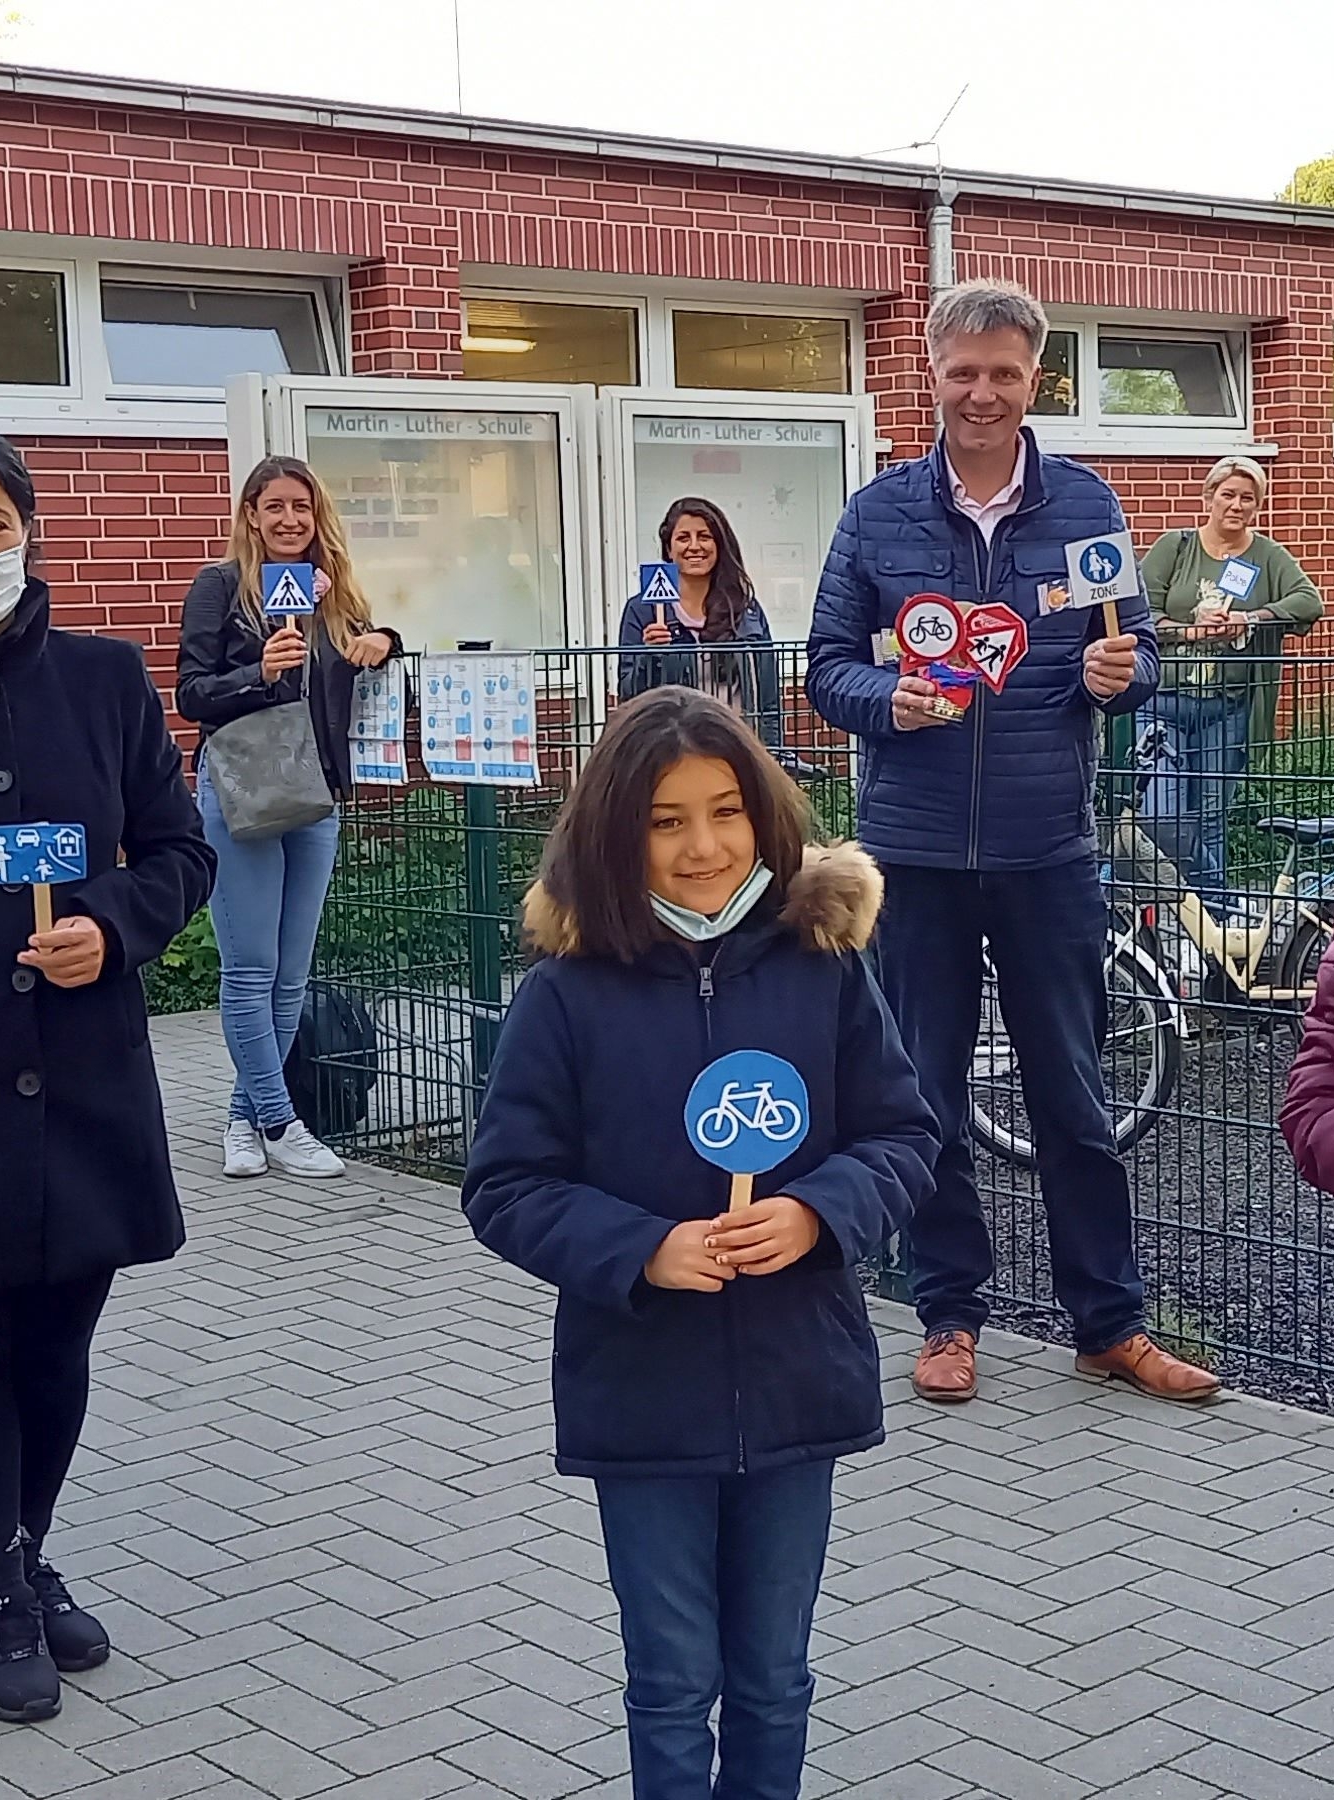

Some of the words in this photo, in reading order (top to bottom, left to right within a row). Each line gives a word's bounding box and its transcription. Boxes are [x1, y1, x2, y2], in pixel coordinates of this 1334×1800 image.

[326, 413, 389, 432] Martin
[405, 415, 462, 434] Luther
[478, 417, 533, 435] Schule
[648, 421, 701, 439] Martin
[714, 423, 762, 441] Luther
[775, 424, 822, 442] Schule
[1089, 583, 1119, 600] ZONE
